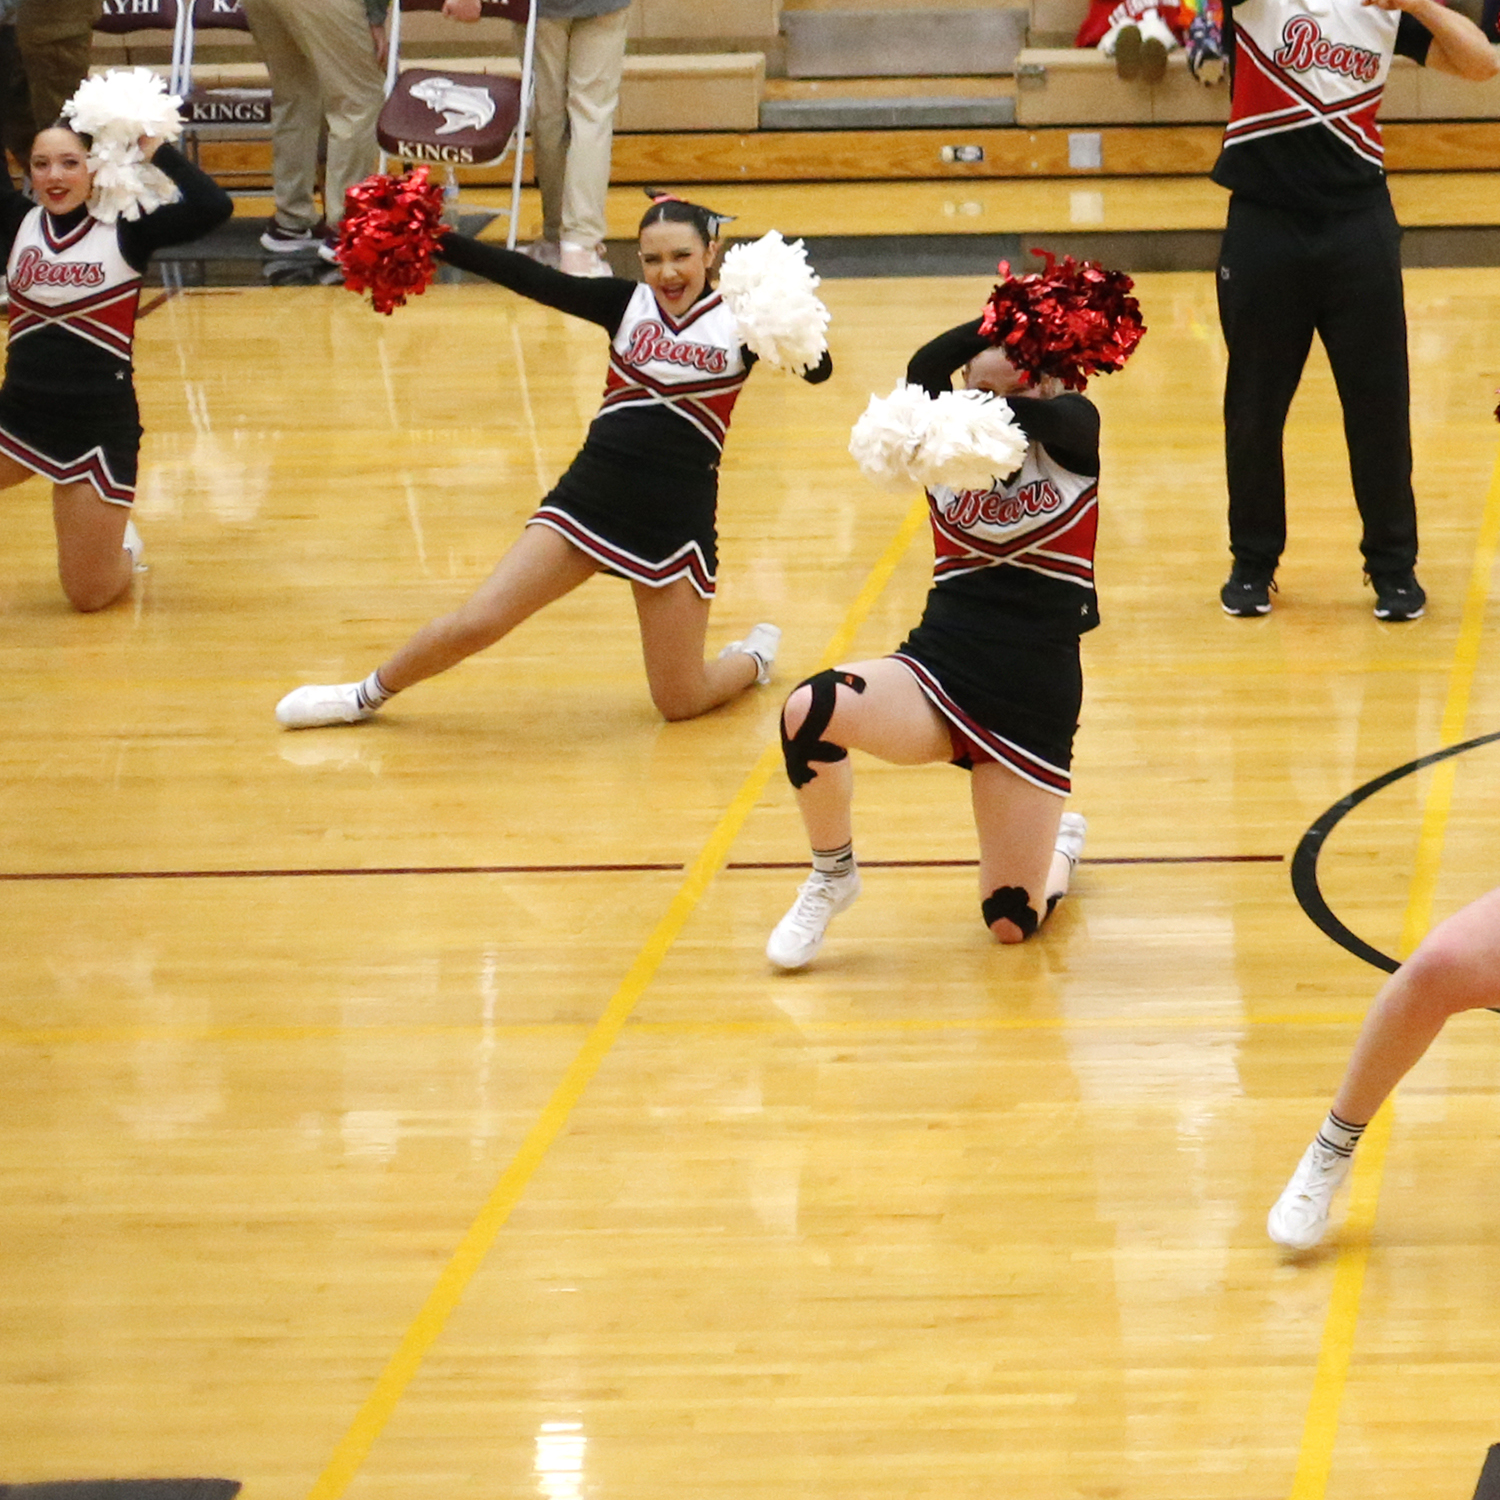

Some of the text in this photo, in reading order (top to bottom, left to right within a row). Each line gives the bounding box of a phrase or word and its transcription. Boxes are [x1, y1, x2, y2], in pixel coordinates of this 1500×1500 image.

[1275, 14, 1382, 82] Bears
[193, 102, 266, 121] KINGS
[398, 141, 474, 163] KINGS
[11, 245, 105, 291] Bears
[625, 319, 729, 374] Bears
[946, 480, 1062, 529] Bears
